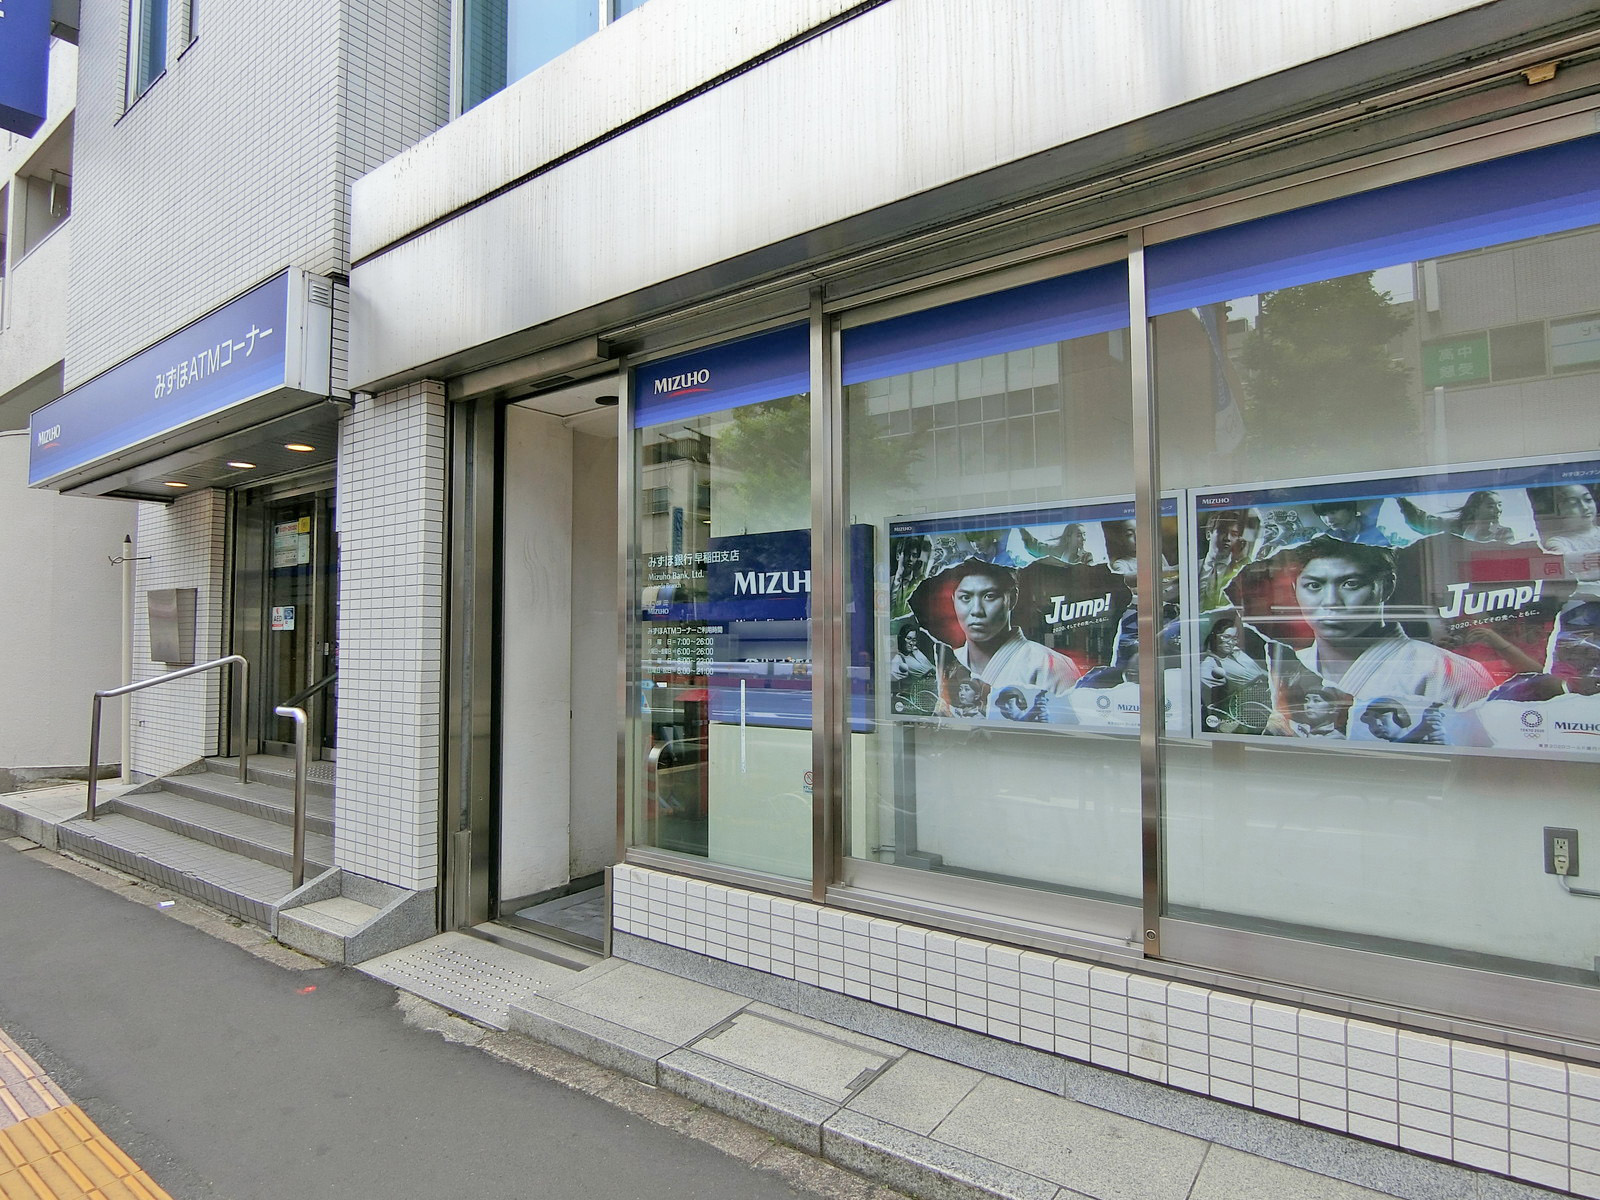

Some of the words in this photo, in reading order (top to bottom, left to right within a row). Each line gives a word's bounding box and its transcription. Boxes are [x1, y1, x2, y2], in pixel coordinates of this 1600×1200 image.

[154, 323, 273, 399] みずほATMコーナー
[654, 369, 710, 395] MIZUHO
[37, 424, 61, 447] MIZUHO
[1202, 497, 1230, 505] MIZUHO
[648, 553, 692, 568] みずほ銀行
[694, 549, 740, 564] 早稲田支店
[648, 572, 671, 581] Mizuho
[672, 570, 690, 580] Bank,
[691, 570, 705, 579] Ltd.
[1044, 593, 1112, 624] Jump!
[1438, 579, 1544, 618] Jump!
